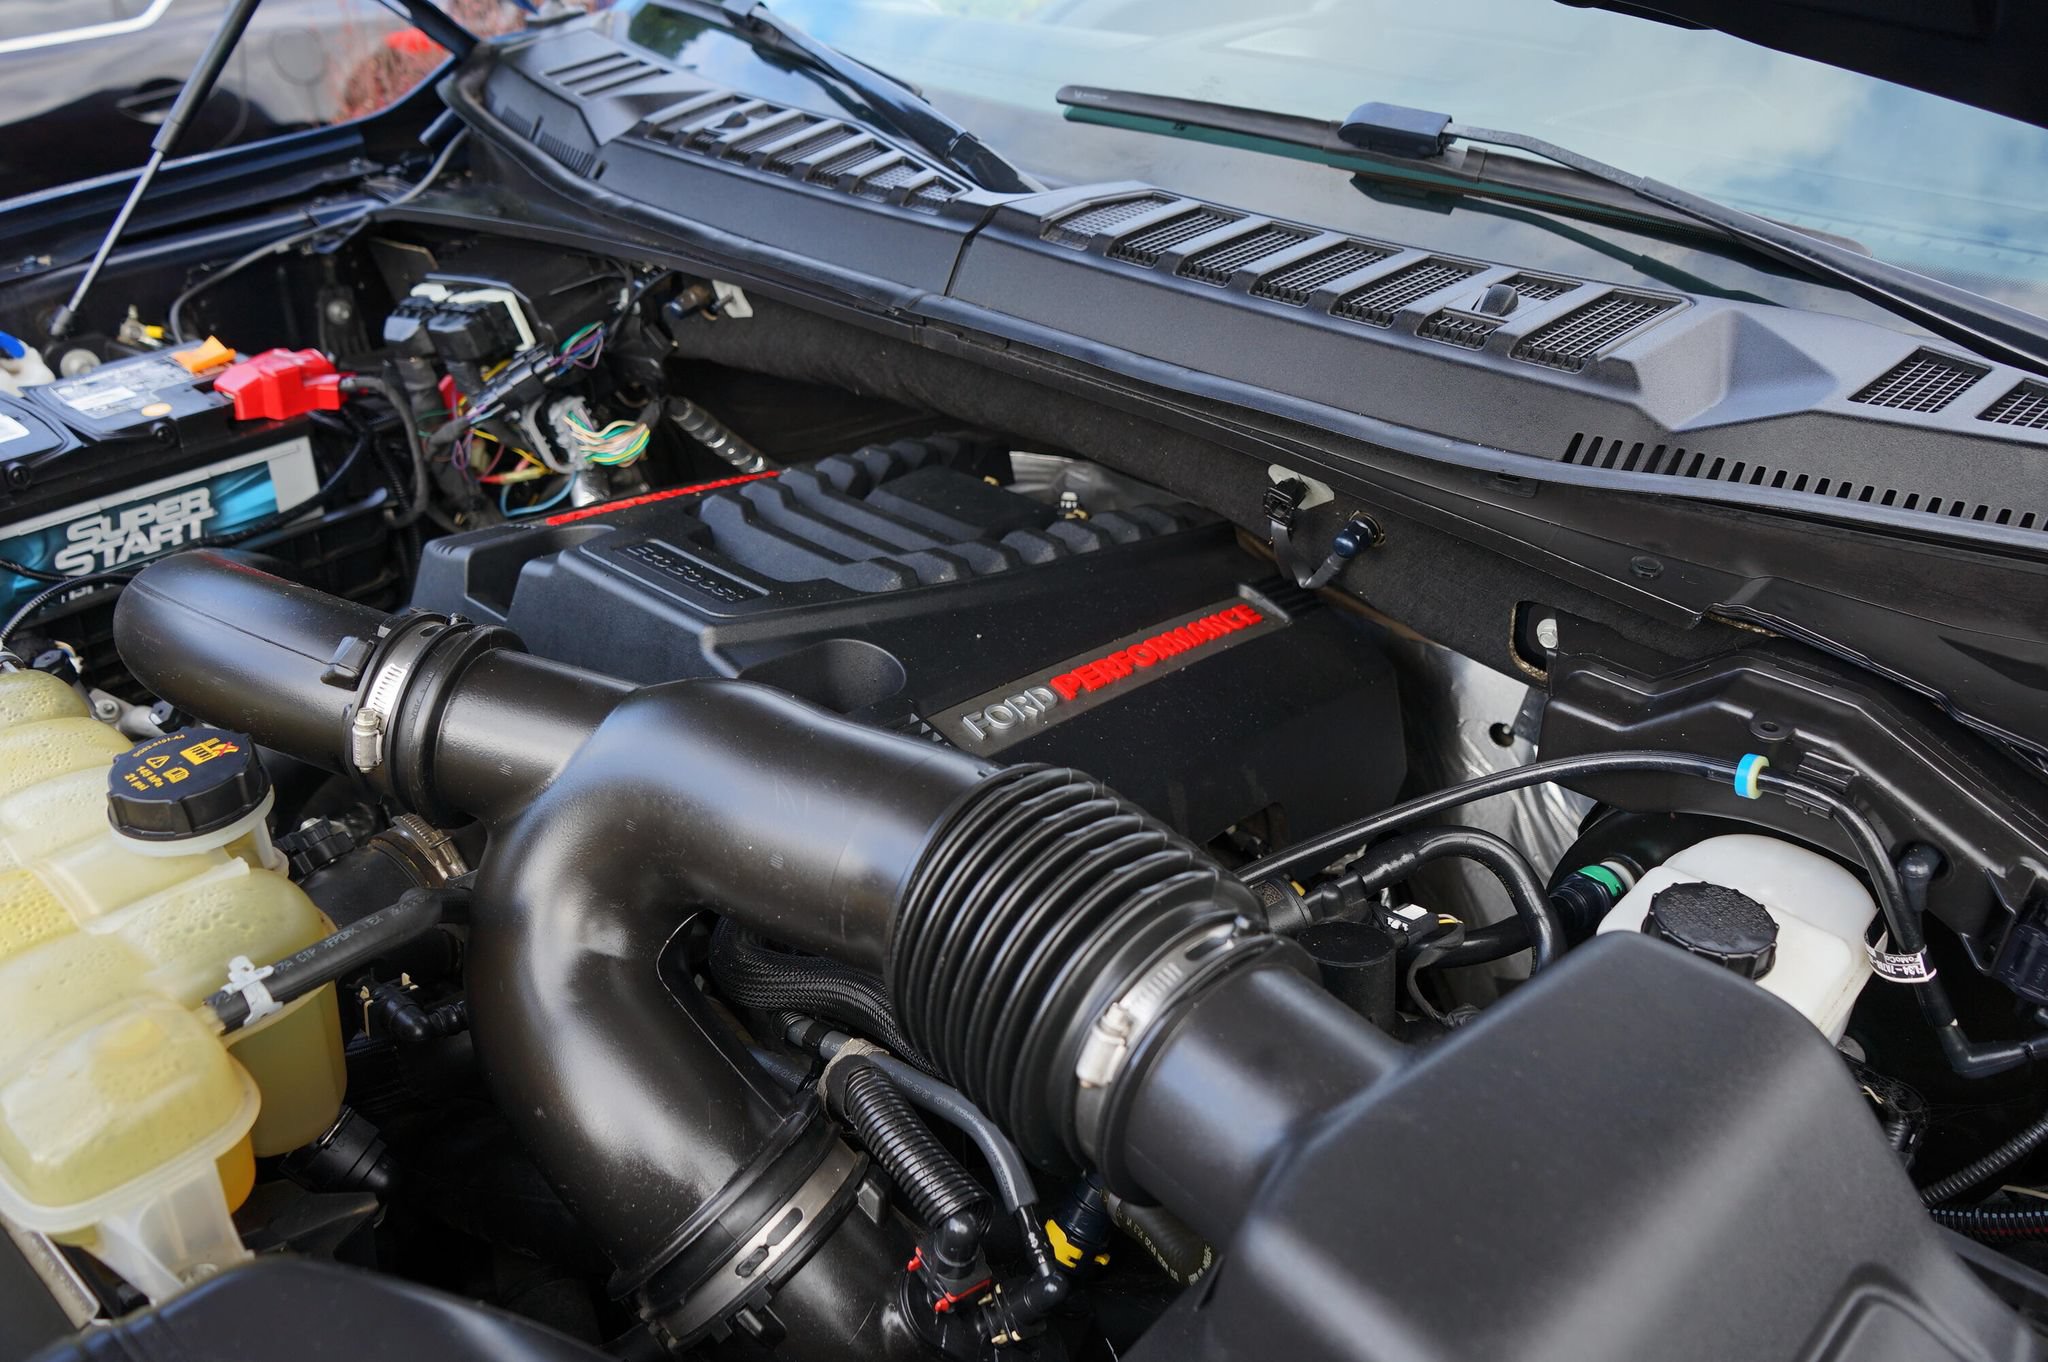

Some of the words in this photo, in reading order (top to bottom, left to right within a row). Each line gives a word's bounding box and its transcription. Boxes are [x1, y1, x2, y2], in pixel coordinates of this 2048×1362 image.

[54, 508, 218, 577] START
[66, 486, 211, 543] SUPER
[962, 685, 1058, 740] FORD
[1050, 604, 1263, 700] PERFORMANCE
